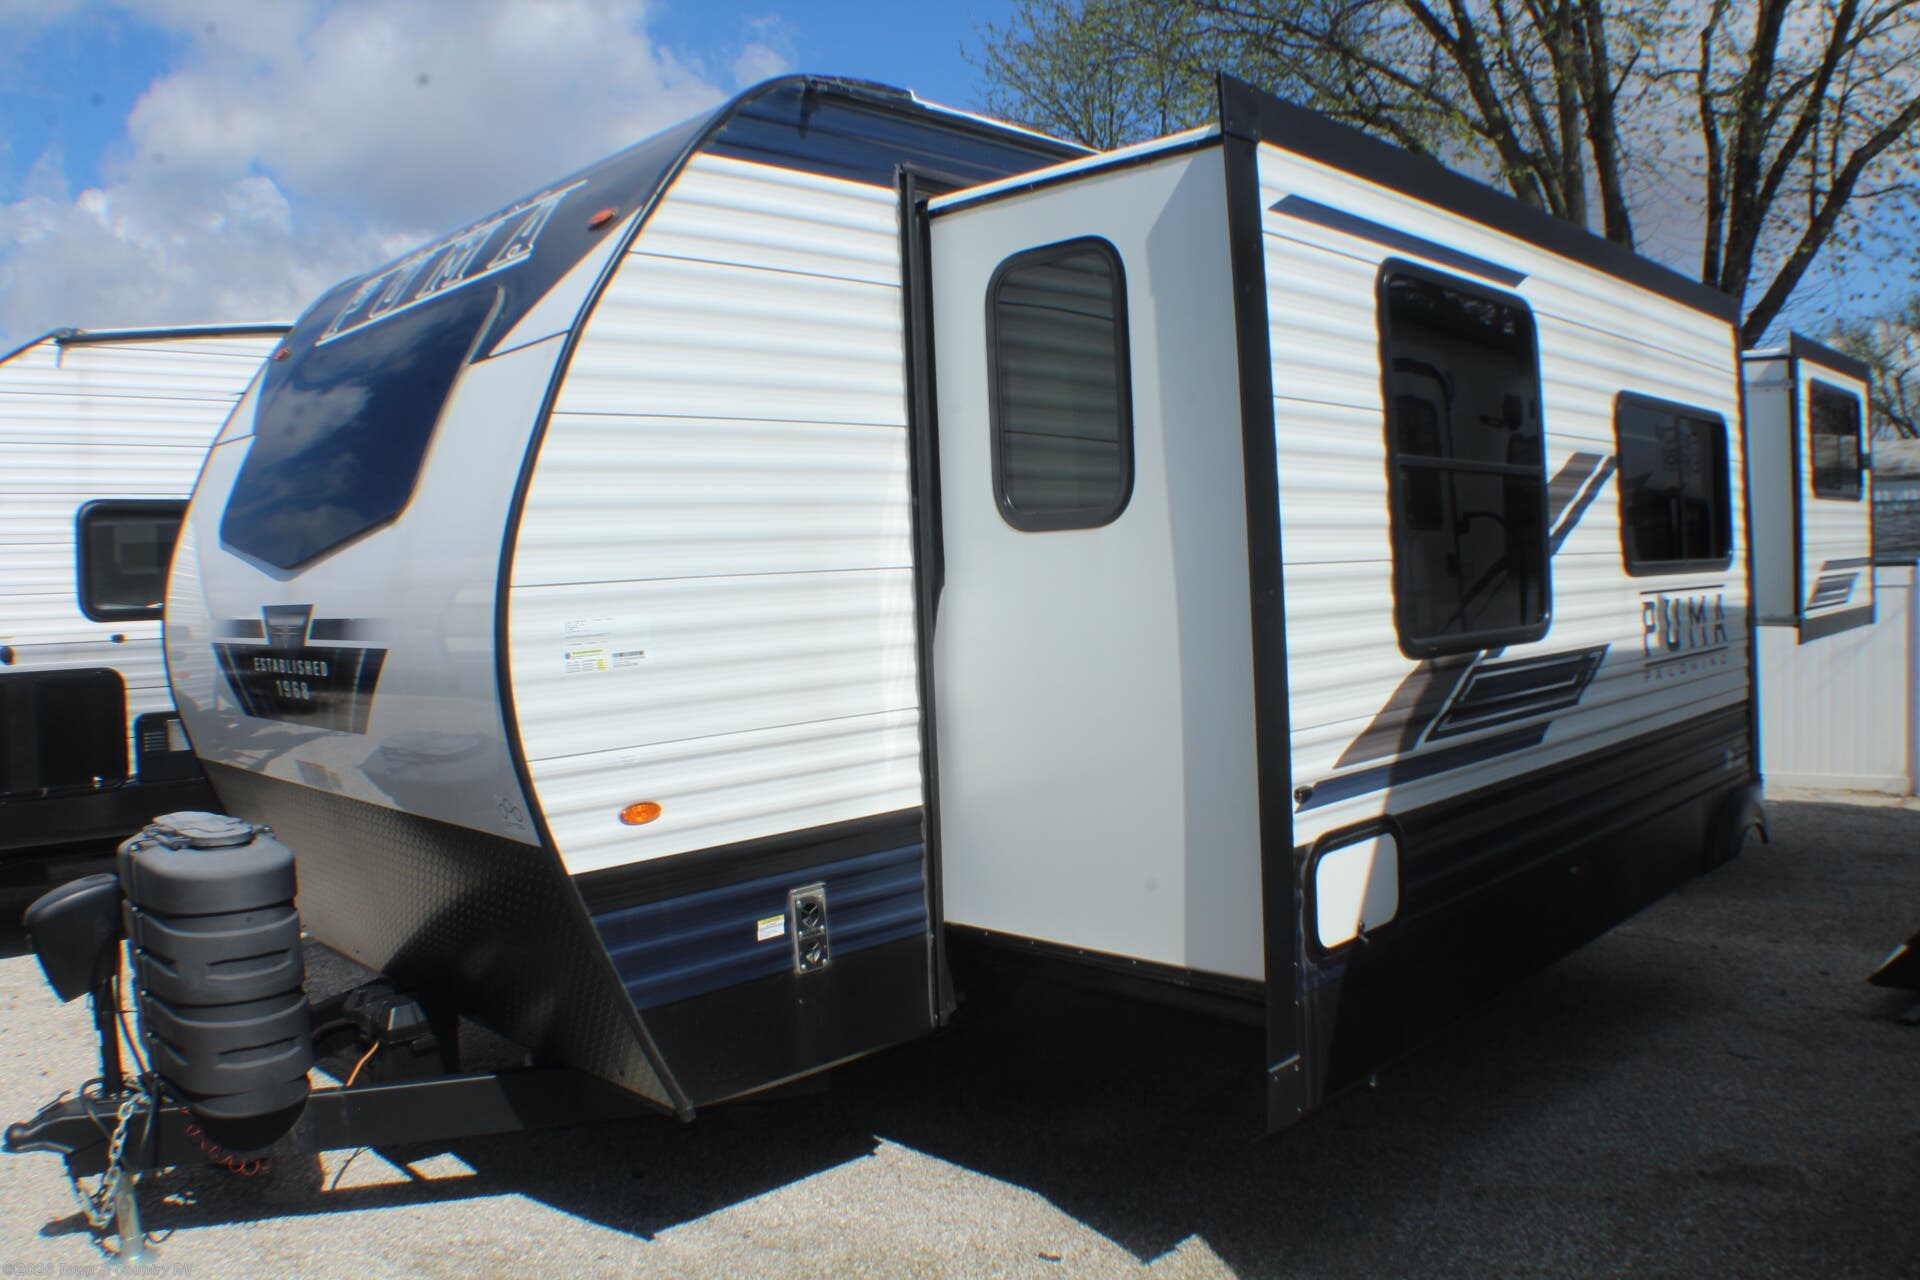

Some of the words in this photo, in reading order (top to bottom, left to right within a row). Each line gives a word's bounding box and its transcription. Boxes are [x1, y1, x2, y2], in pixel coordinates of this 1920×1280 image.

[1642, 593, 1727, 657] PUMA
[254, 656, 328, 677] ESTABLISHED
[275, 680, 310, 700] 1968
